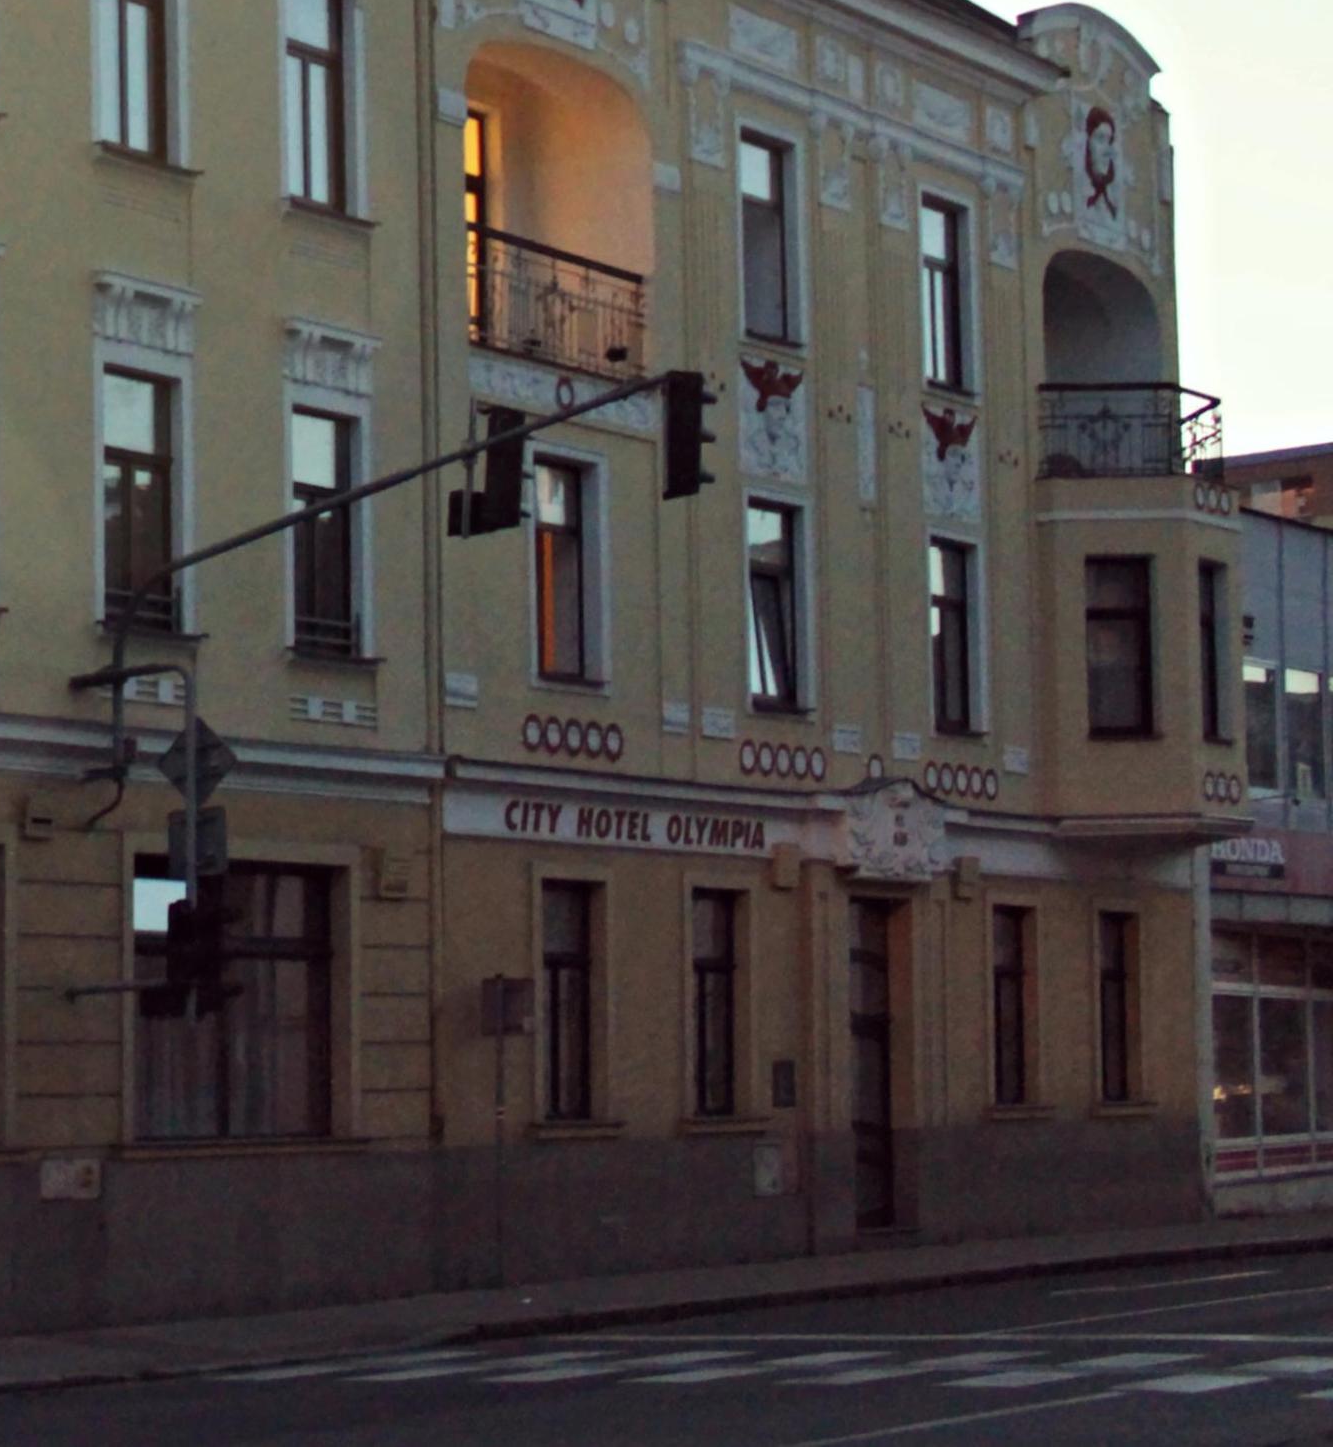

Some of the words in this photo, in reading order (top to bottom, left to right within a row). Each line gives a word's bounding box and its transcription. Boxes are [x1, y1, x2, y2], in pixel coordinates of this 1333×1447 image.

[504, 800, 562, 834] CITY
[576, 807, 652, 842] HOTEL
[666, 814, 765, 849] OLYMPIA
[1211, 838, 1285, 865] HONDA
